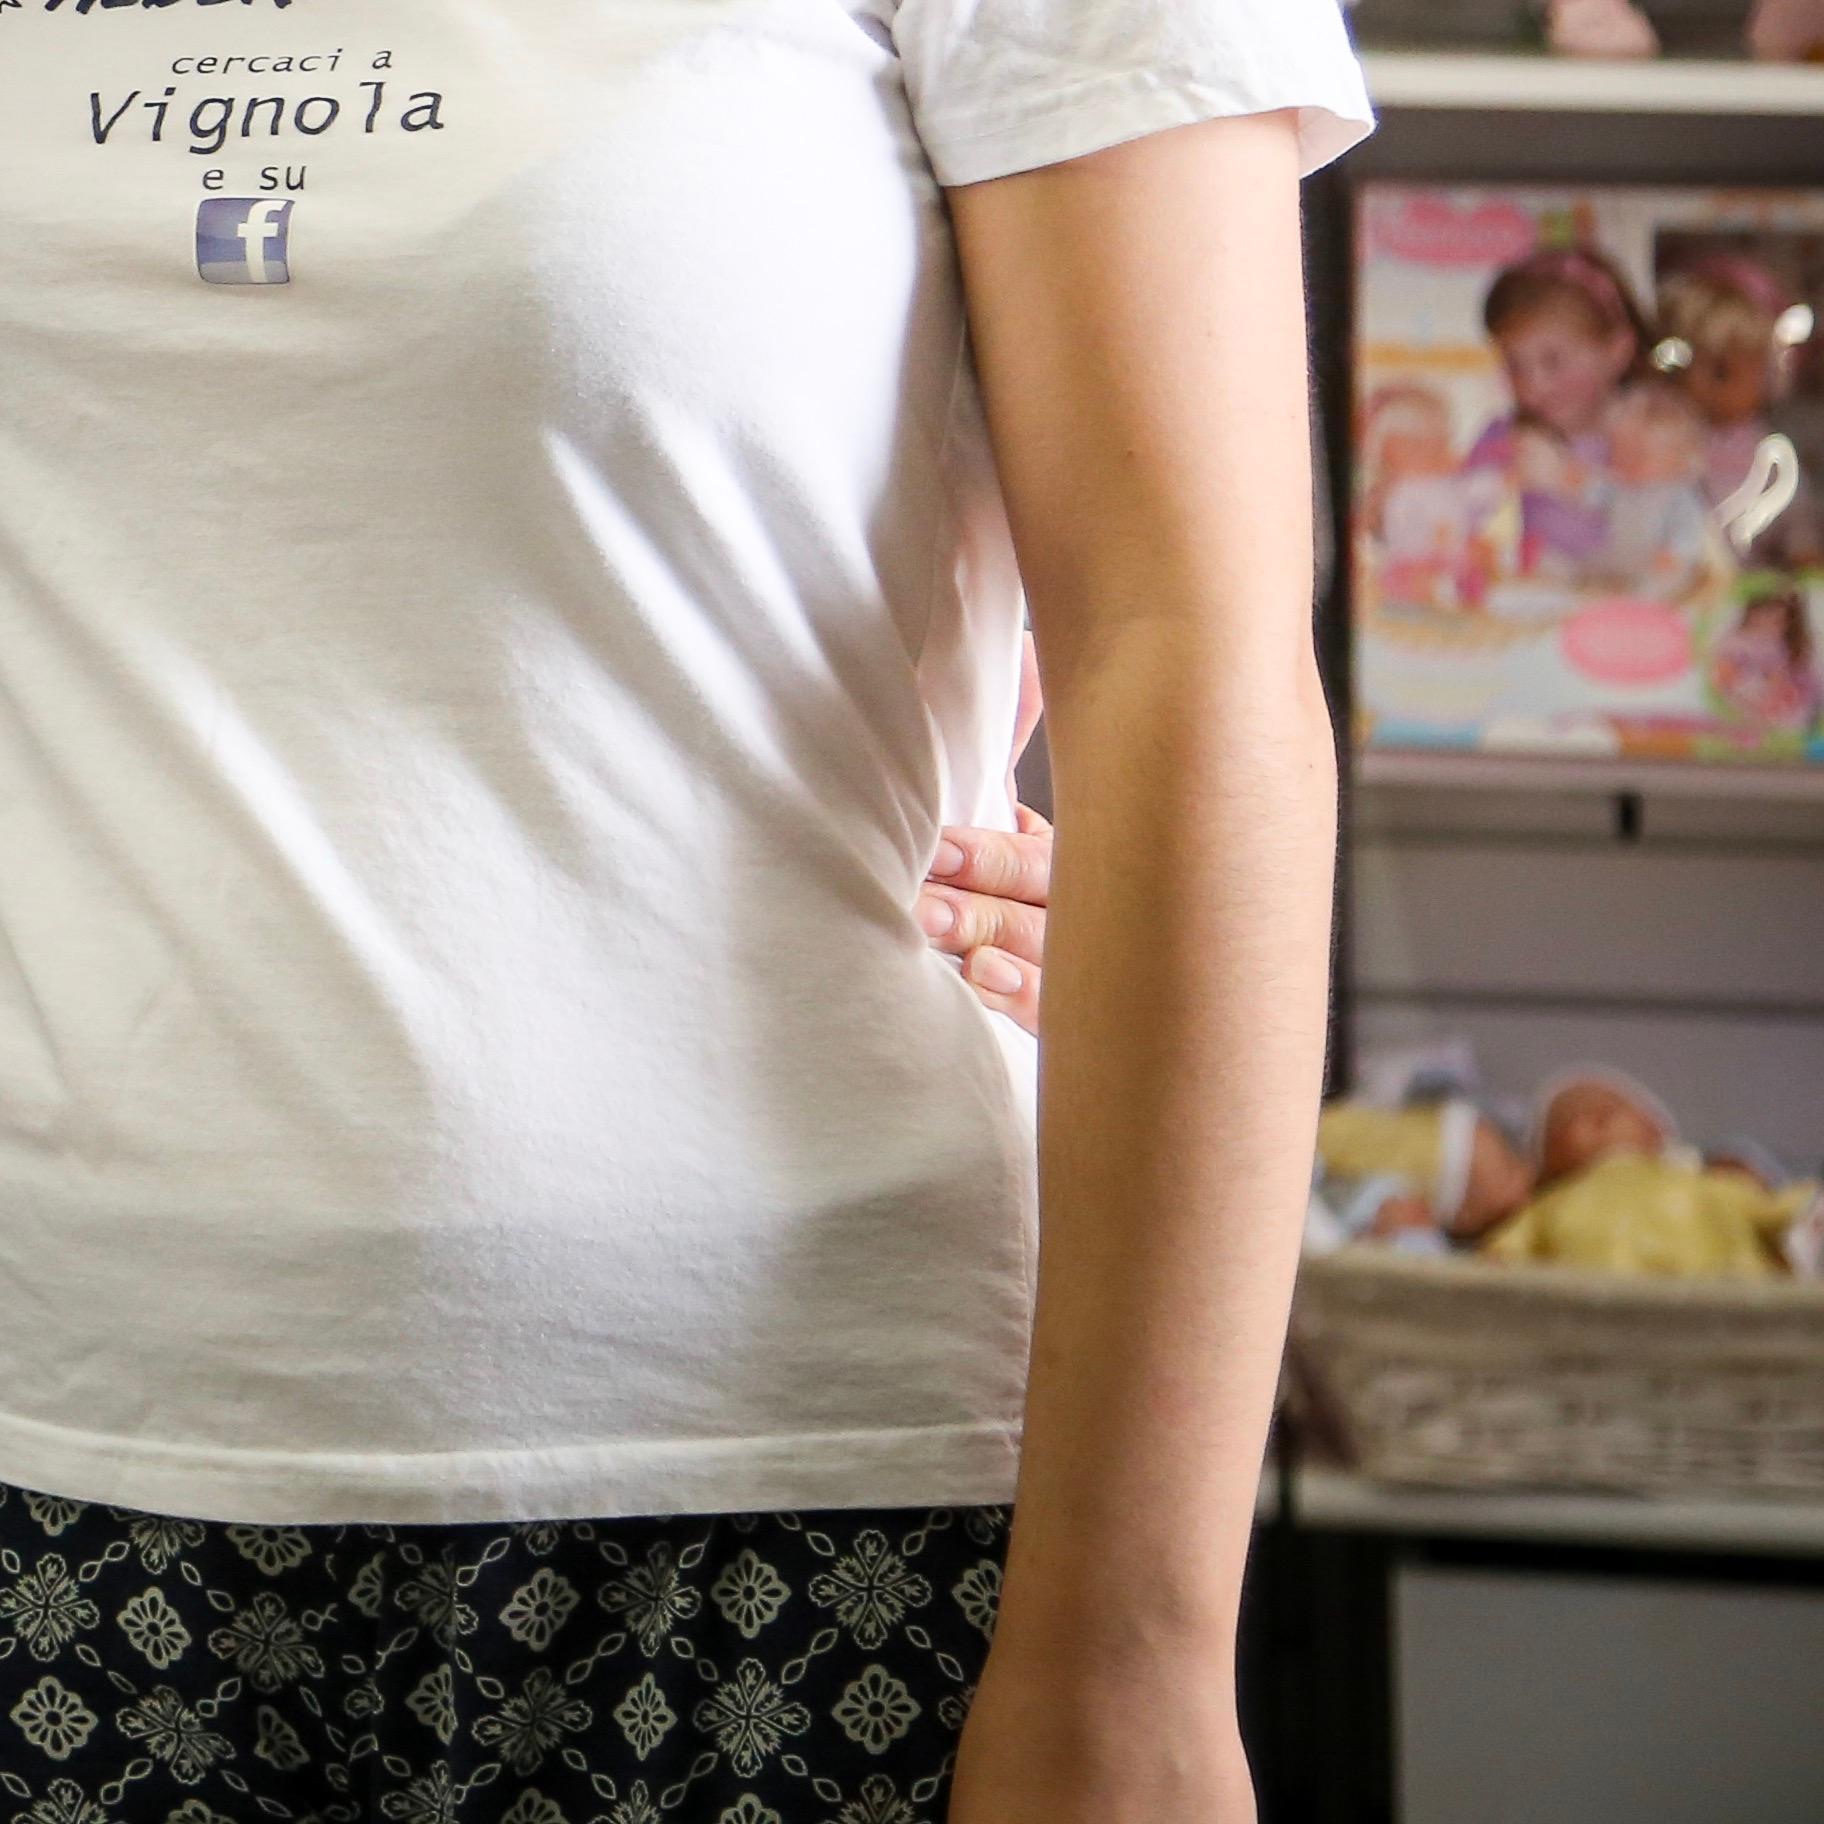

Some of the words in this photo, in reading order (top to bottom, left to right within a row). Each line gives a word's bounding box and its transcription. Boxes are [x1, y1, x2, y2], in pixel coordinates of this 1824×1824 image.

[171, 48, 344, 75] cercaci
[371, 49, 393, 71] a
[88, 80, 446, 156] Vignola
[202, 168, 225, 191] e
[258, 165, 307, 192] su
